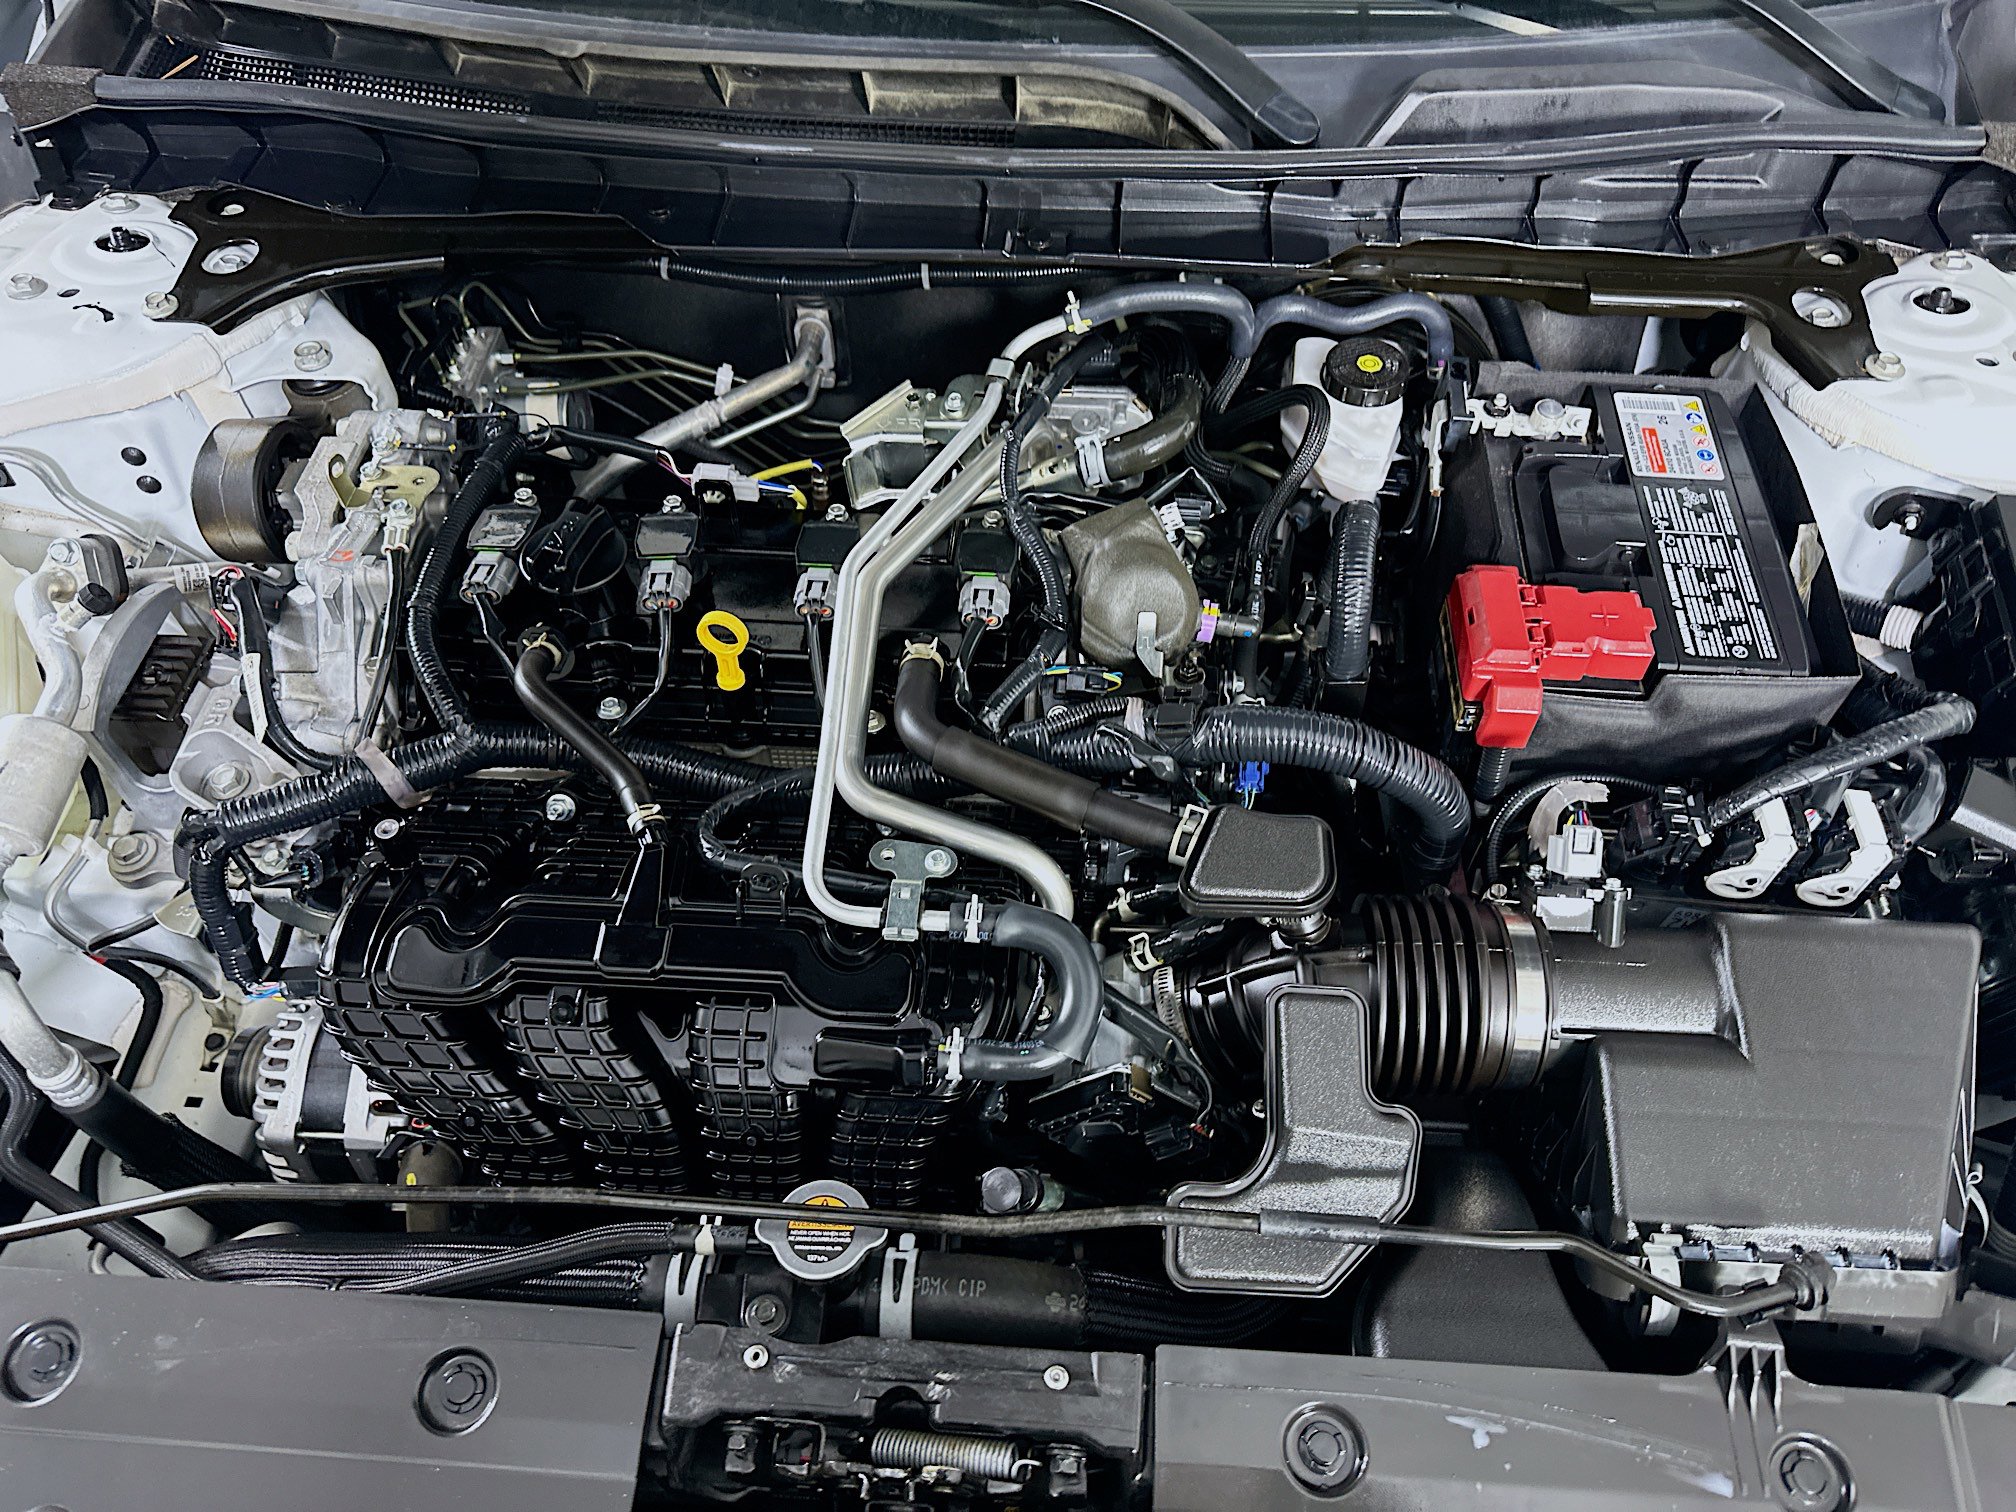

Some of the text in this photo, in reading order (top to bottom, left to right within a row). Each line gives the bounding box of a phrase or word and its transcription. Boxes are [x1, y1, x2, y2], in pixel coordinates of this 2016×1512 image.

[1624, 421, 1636, 446] NISSAN
[1631, 448, 1643, 472] RENAULT
[958, 1279, 987, 1297] CIP
